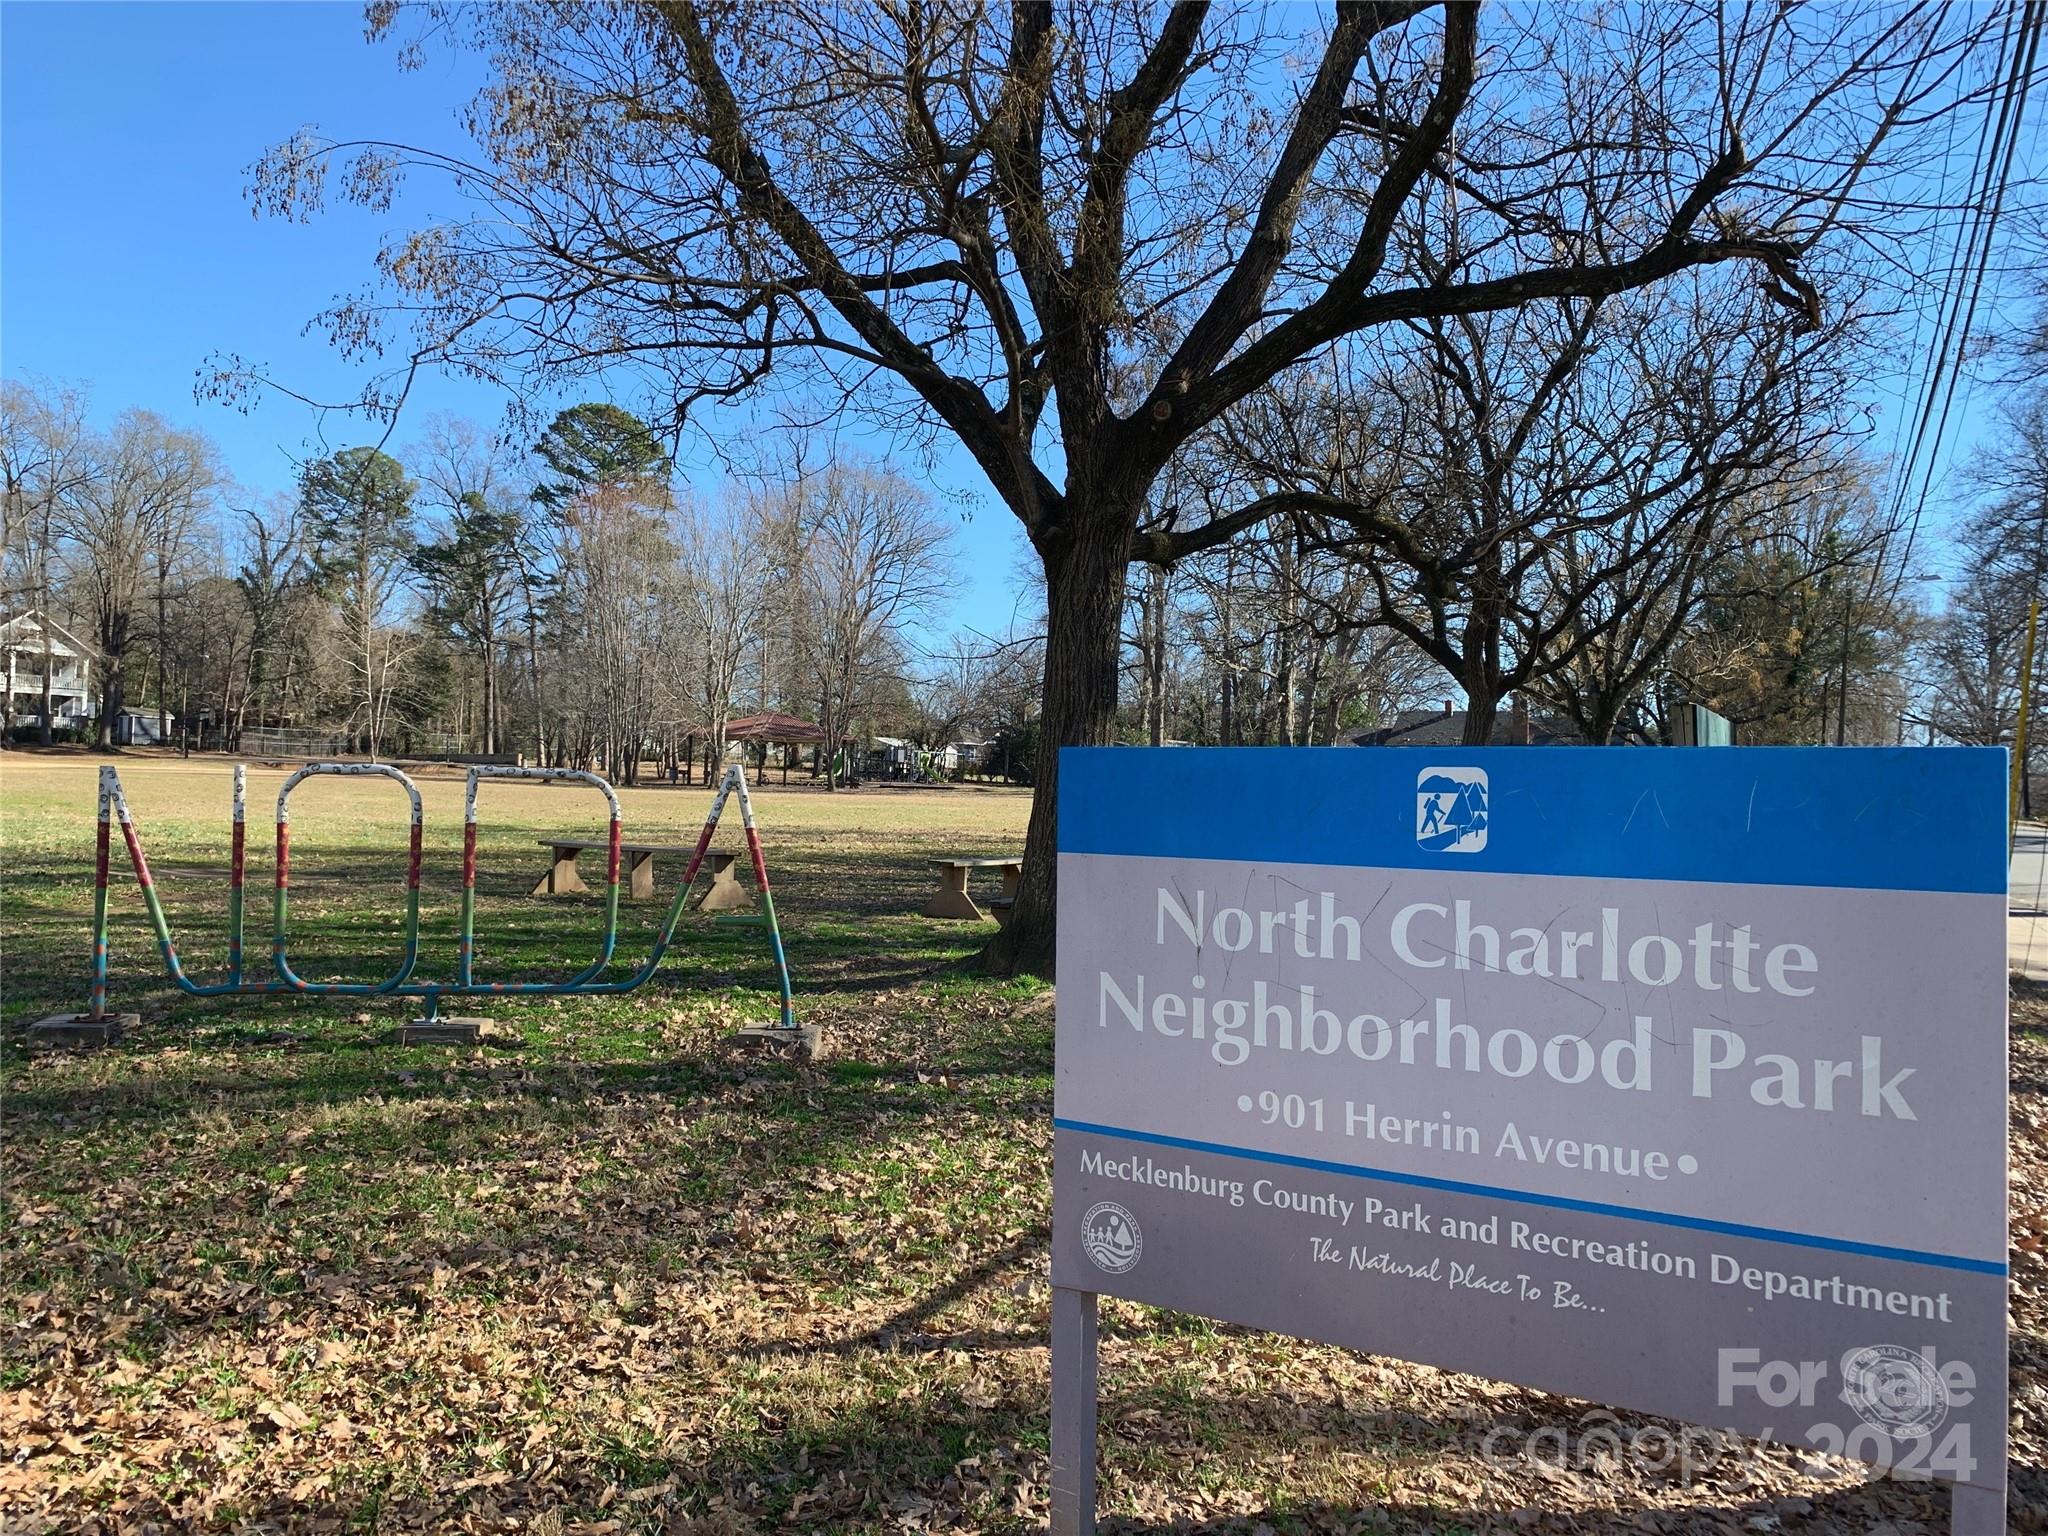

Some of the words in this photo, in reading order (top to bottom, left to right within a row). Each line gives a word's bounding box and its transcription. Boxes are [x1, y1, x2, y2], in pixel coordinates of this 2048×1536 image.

[1157, 888, 1362, 961] North
[1390, 899, 1819, 997] Charlotte
[1098, 971, 1654, 1092] Neighborhood
[1692, 1028, 1919, 1122] Park
[1345, 1101, 1481, 1158] Herrin
[1079, 1149, 1246, 1209] Mecklenburg
[1252, 1179, 1355, 1227] County
[1365, 1197, 1432, 1234] Park
[1440, 1217, 1498, 1247] and
[1510, 1220, 1697, 1280] Recreation
[1710, 1253, 1954, 1325] Department
[1310, 1236, 1344, 1264] The
[1348, 1245, 1443, 1284] Natural
[1448, 1261, 1513, 1296] Place
[1516, 1274, 1542, 1302] To
